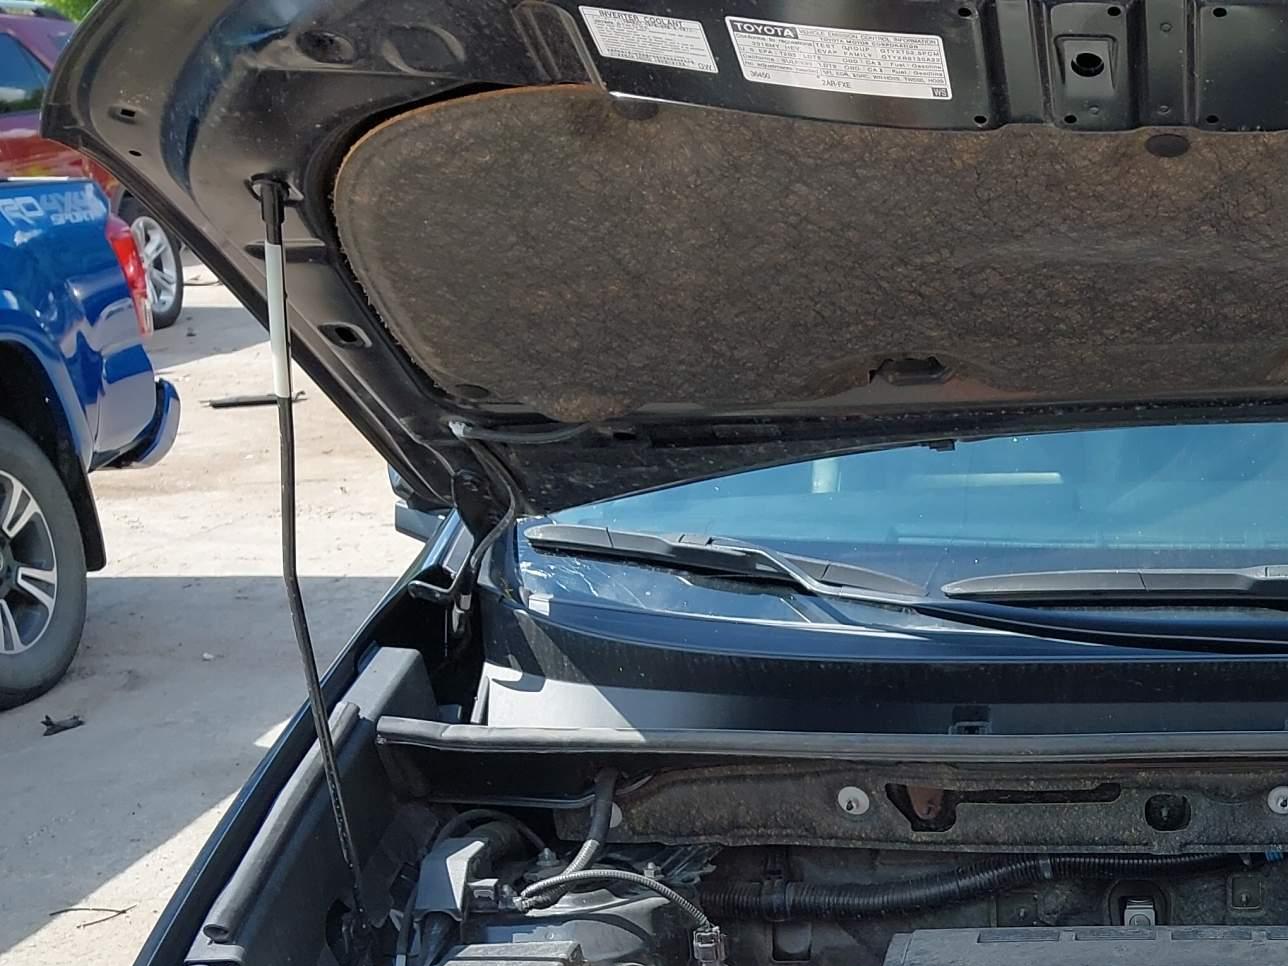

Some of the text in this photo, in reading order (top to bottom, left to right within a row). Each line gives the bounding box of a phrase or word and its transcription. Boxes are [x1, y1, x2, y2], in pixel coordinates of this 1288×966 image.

[598, 10, 683, 27] INVERTER COOLANT
[733, 22, 794, 38] TOYOTA
